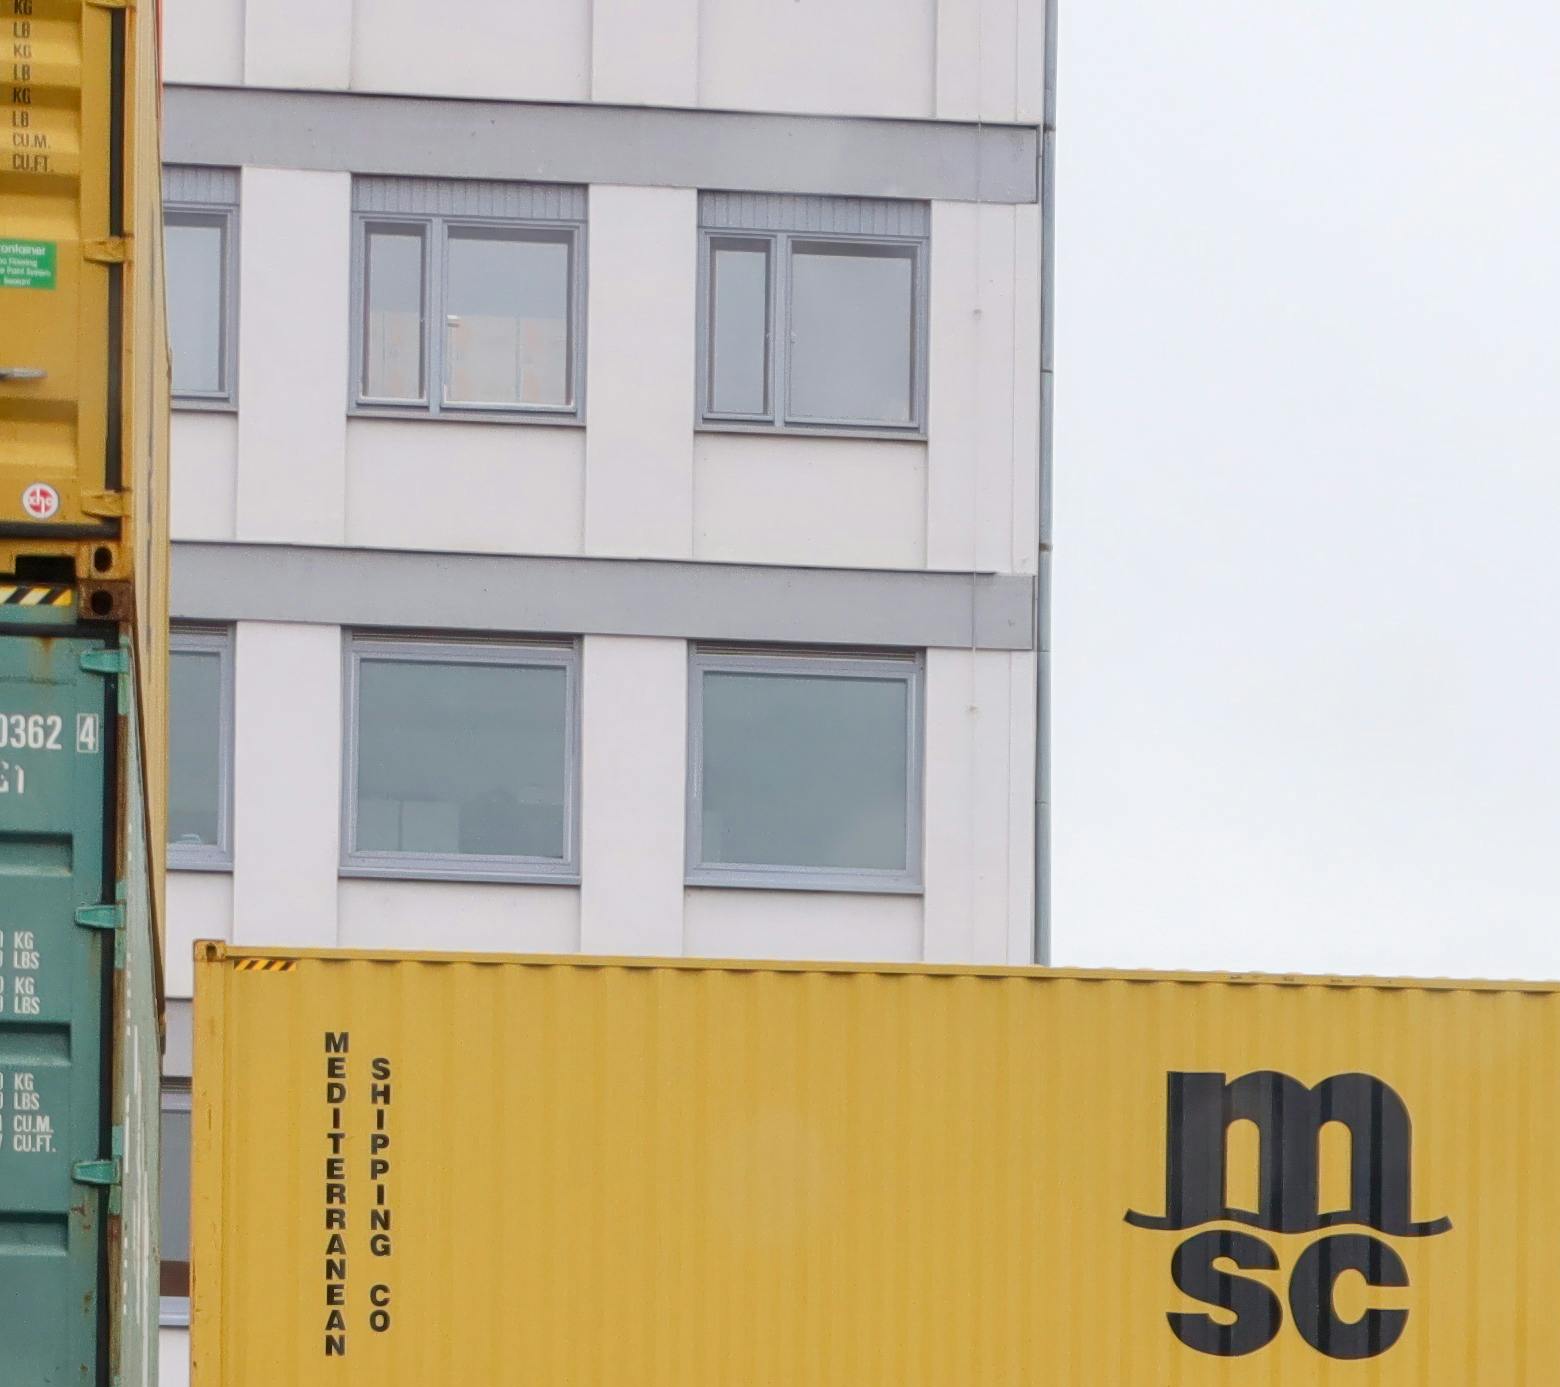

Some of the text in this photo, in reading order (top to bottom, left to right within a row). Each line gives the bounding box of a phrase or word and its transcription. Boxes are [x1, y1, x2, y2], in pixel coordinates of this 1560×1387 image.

[13, 88, 31, 104] KG
[14, 931, 34, 949] KG
[13, 952, 39, 970] LBS
[15, 976, 34, 995] KG
[14, 997, 40, 1014] LBS
[14, 1073, 33, 1090] KG
[13, 1092, 39, 1110] LBS
[325, 1031, 350, 1357] MEDITERRANEAN
[369, 1057, 392, 1333] SHIPPING CO
